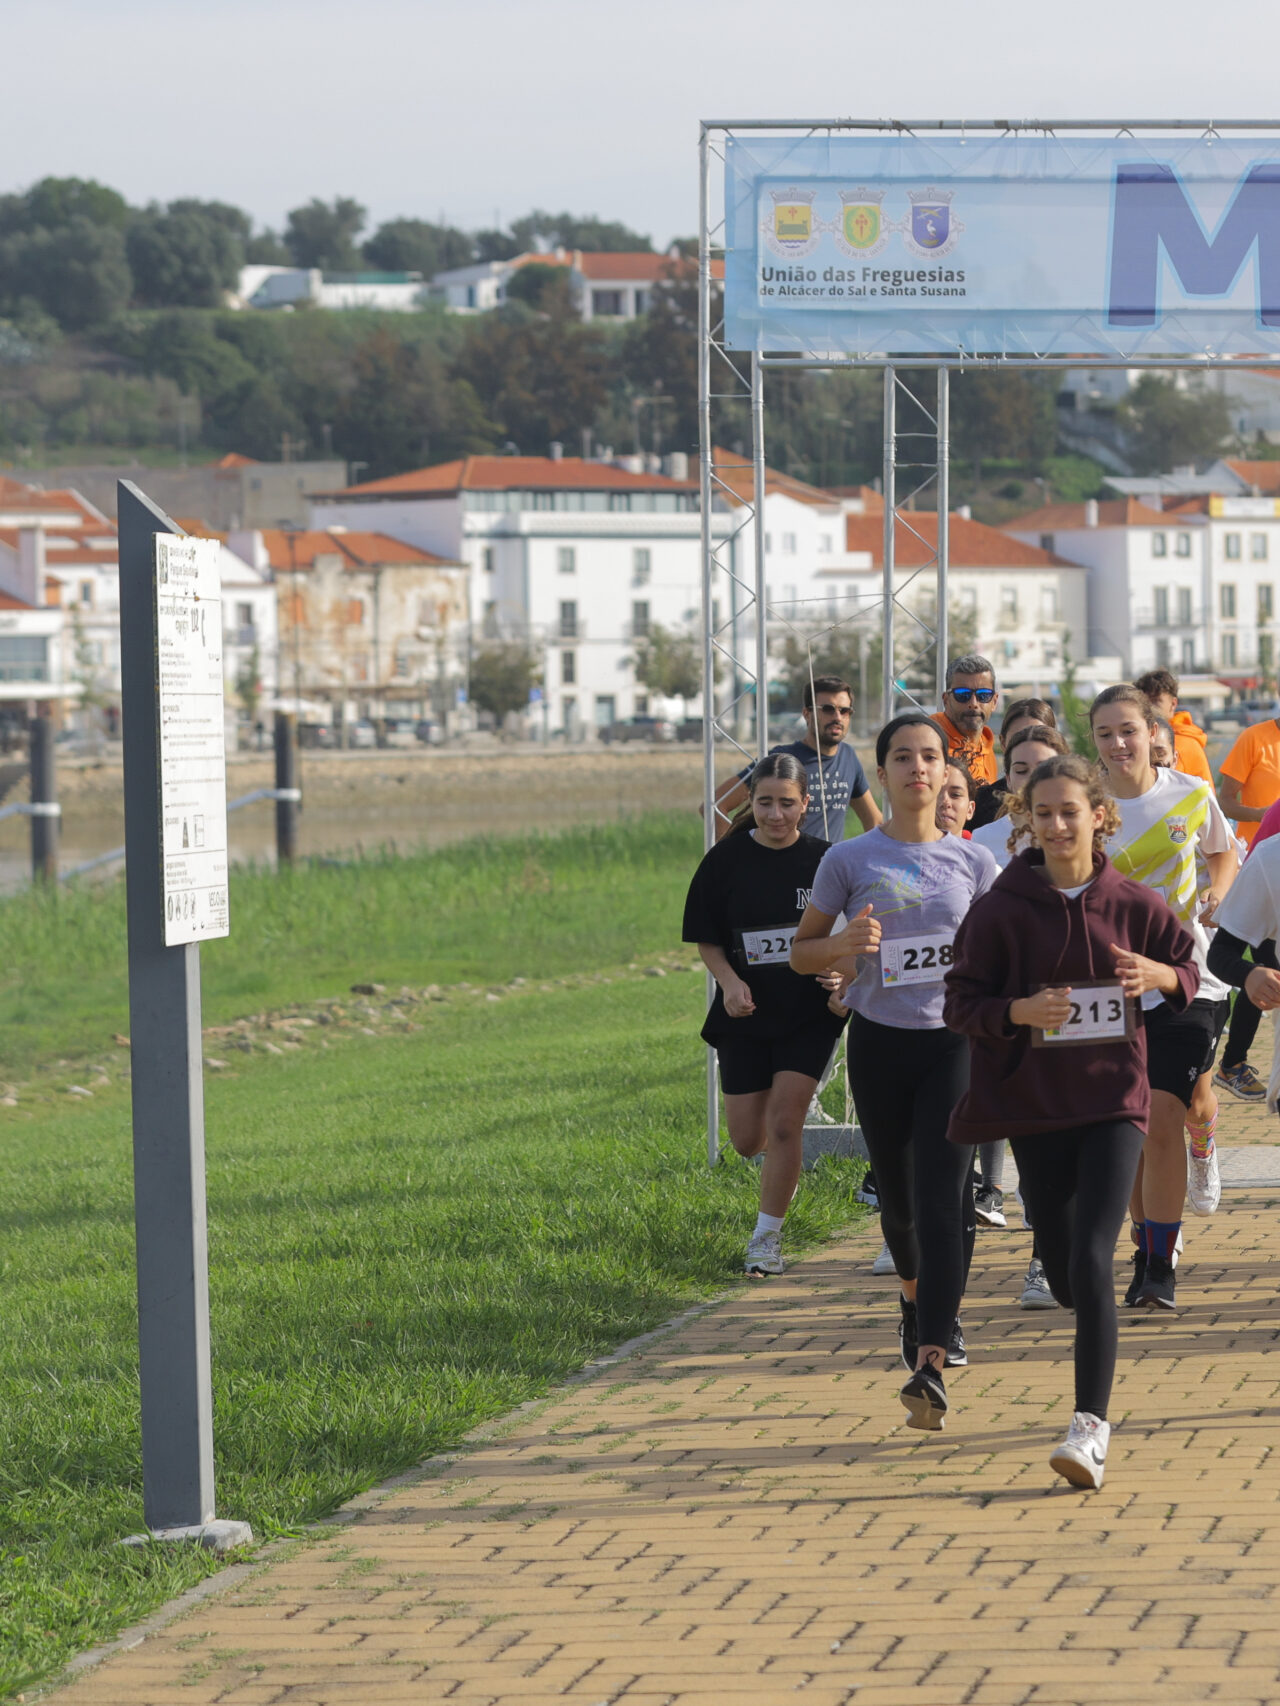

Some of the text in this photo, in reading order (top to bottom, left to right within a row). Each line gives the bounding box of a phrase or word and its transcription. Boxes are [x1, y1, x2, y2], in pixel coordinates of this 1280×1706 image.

[761, 266, 965, 286] União das Freguesias
[759, 285, 966, 297] de Alcácer do Sal e Santa Susana
[807, 781, 828, 790] ood
[903, 944, 955, 971] 228
[1067, 999, 1122, 1025] 213
